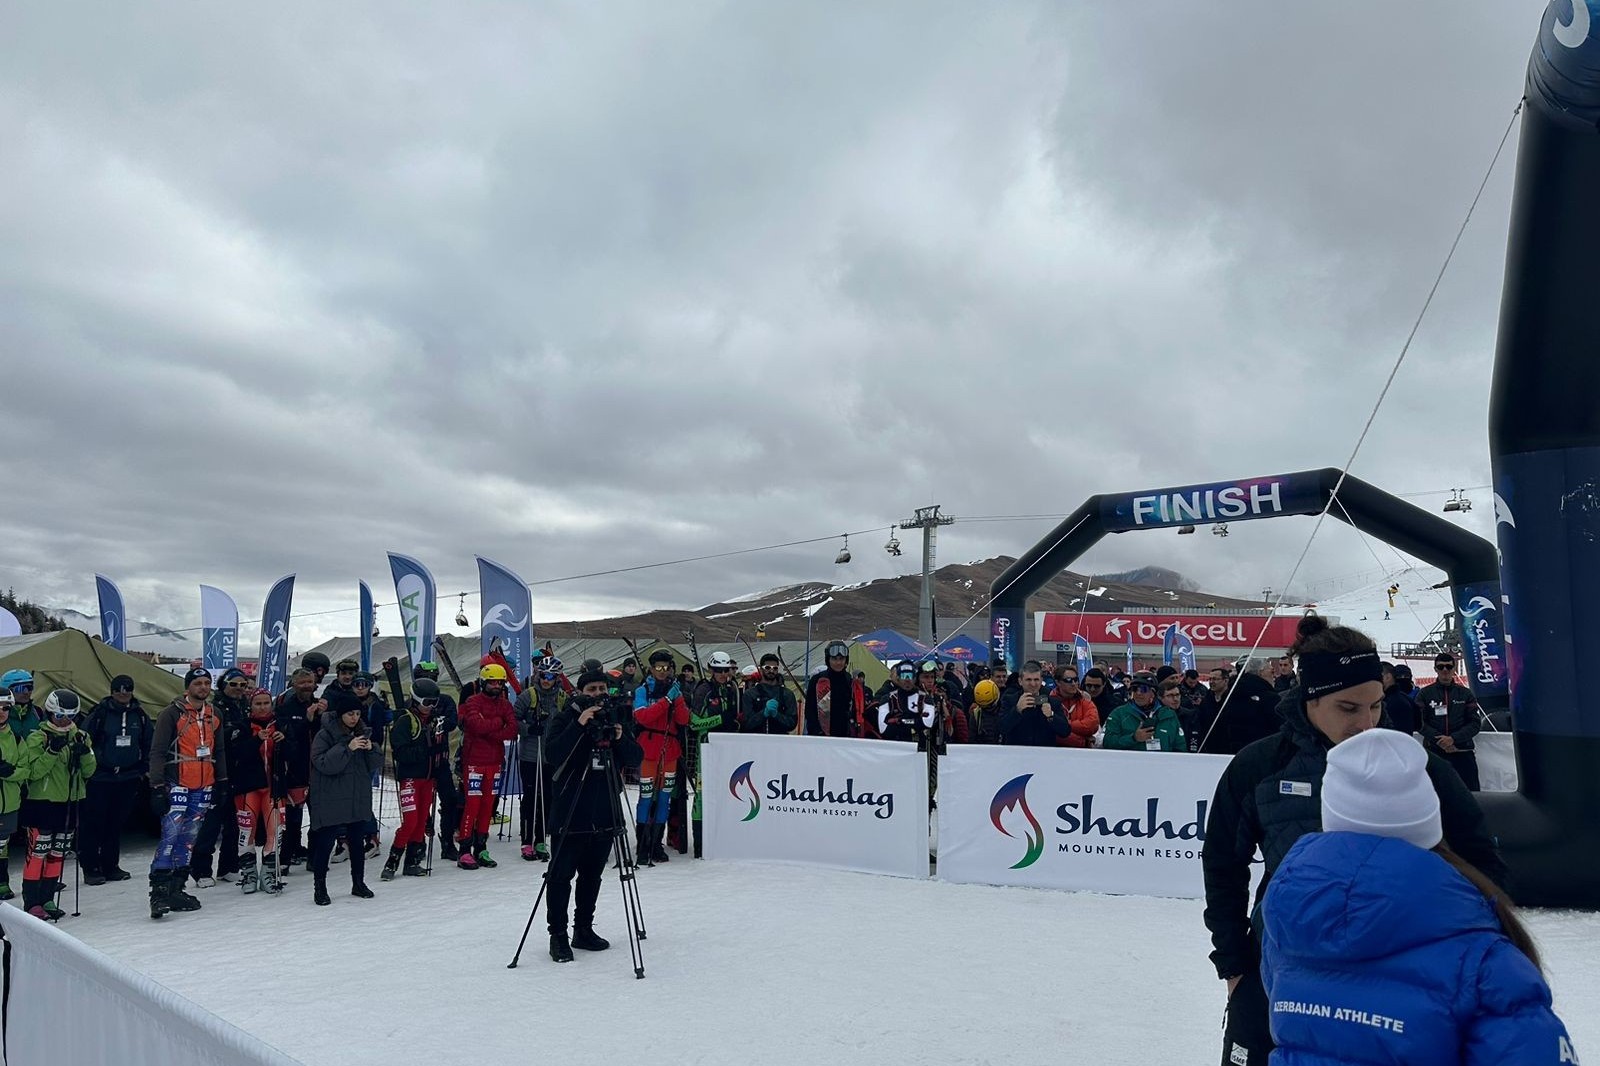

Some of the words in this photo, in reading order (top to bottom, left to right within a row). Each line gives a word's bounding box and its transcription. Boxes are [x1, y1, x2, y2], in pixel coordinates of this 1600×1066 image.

[1133, 482, 1282, 525] FINISH
[1137, 620, 1247, 642] bakcell
[767, 773, 893, 819] Shahdag
[768, 805, 818, 815] MOUNTAIN
[823, 808, 859, 817] RESORT
[1056, 794, 1208, 841] Shahd
[1058, 843, 1145, 857] MOUNTAIN
[1274, 1001, 1331, 1018] AZERBAIJAN
[1334, 1007, 1404, 1034] ATHLETE
